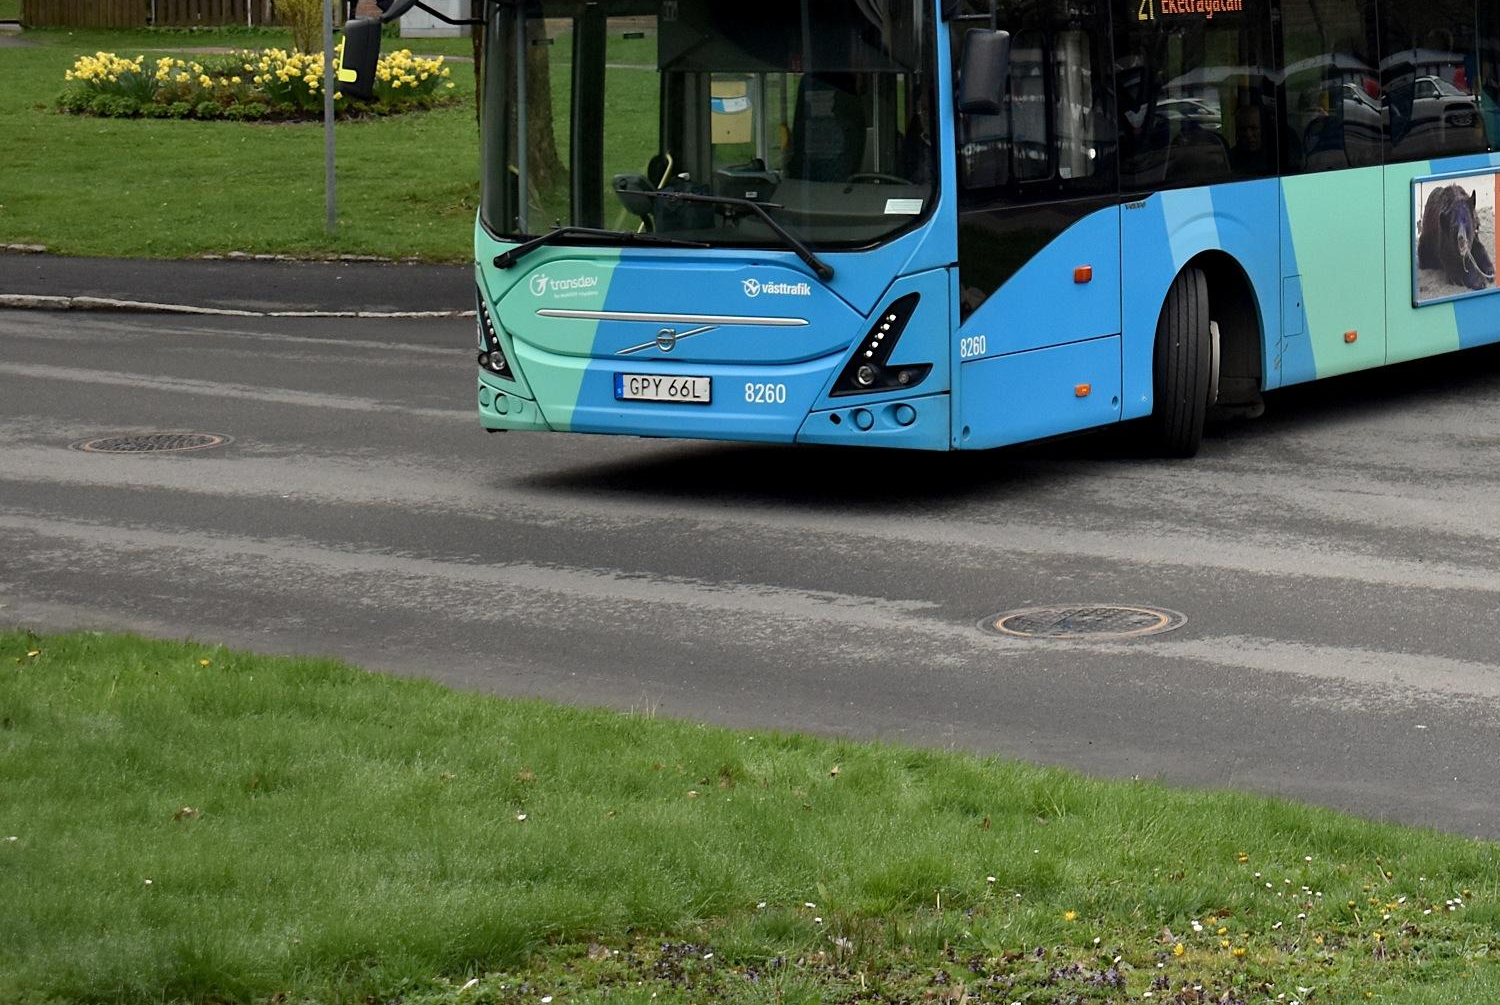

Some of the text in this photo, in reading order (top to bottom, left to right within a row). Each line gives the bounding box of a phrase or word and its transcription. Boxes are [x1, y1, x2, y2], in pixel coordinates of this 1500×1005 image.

[550, 275, 599, 291] transdev
[761, 281, 811, 296] västtrafik
[960, 334, 986, 358] 8260
[629, 377, 702, 399] GPY 66L
[745, 382, 787, 404] 8260
